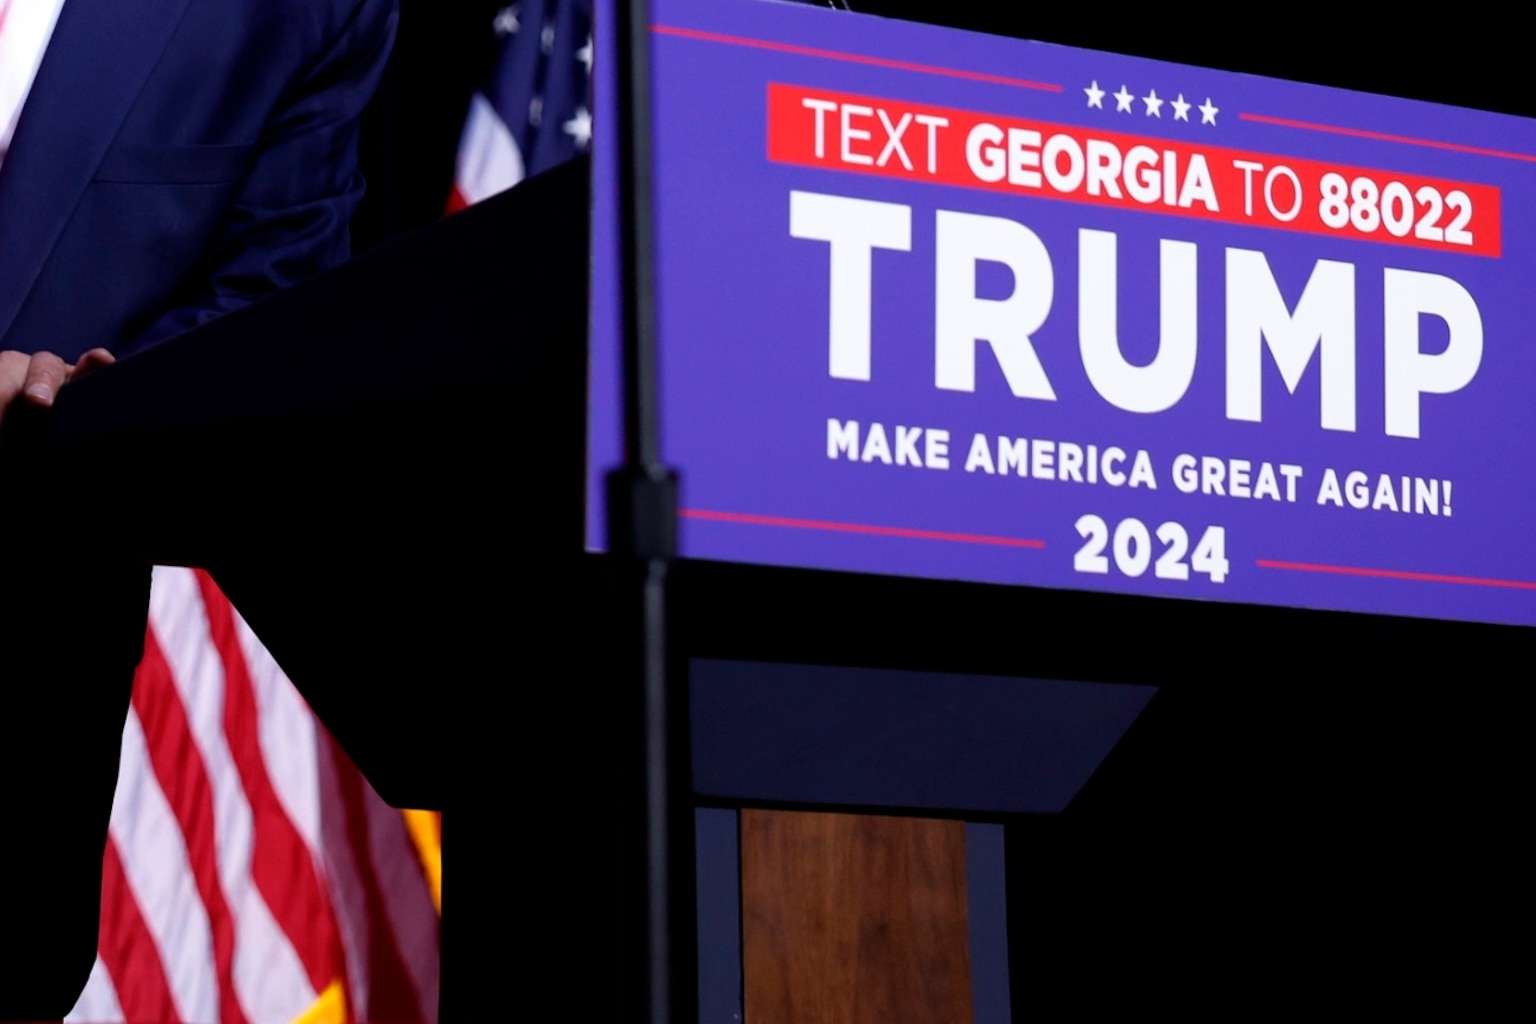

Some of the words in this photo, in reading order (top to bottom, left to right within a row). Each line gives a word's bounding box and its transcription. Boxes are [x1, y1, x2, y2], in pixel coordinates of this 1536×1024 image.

[802, 98, 949, 174] TEXT
[965, 122, 1220, 212] GEORGIA
[1234, 159, 1303, 222] TO
[1318, 172, 1473, 246] 88022
[789, 189, 1484, 439] TRUMP
[826, 418, 950, 470] MAKE
[964, 433, 1158, 490] AMERICA
[1171, 453, 1303, 503] GREAT
[1316, 468, 1452, 517] AGAIN!
[1073, 514, 1230, 584] 2024
